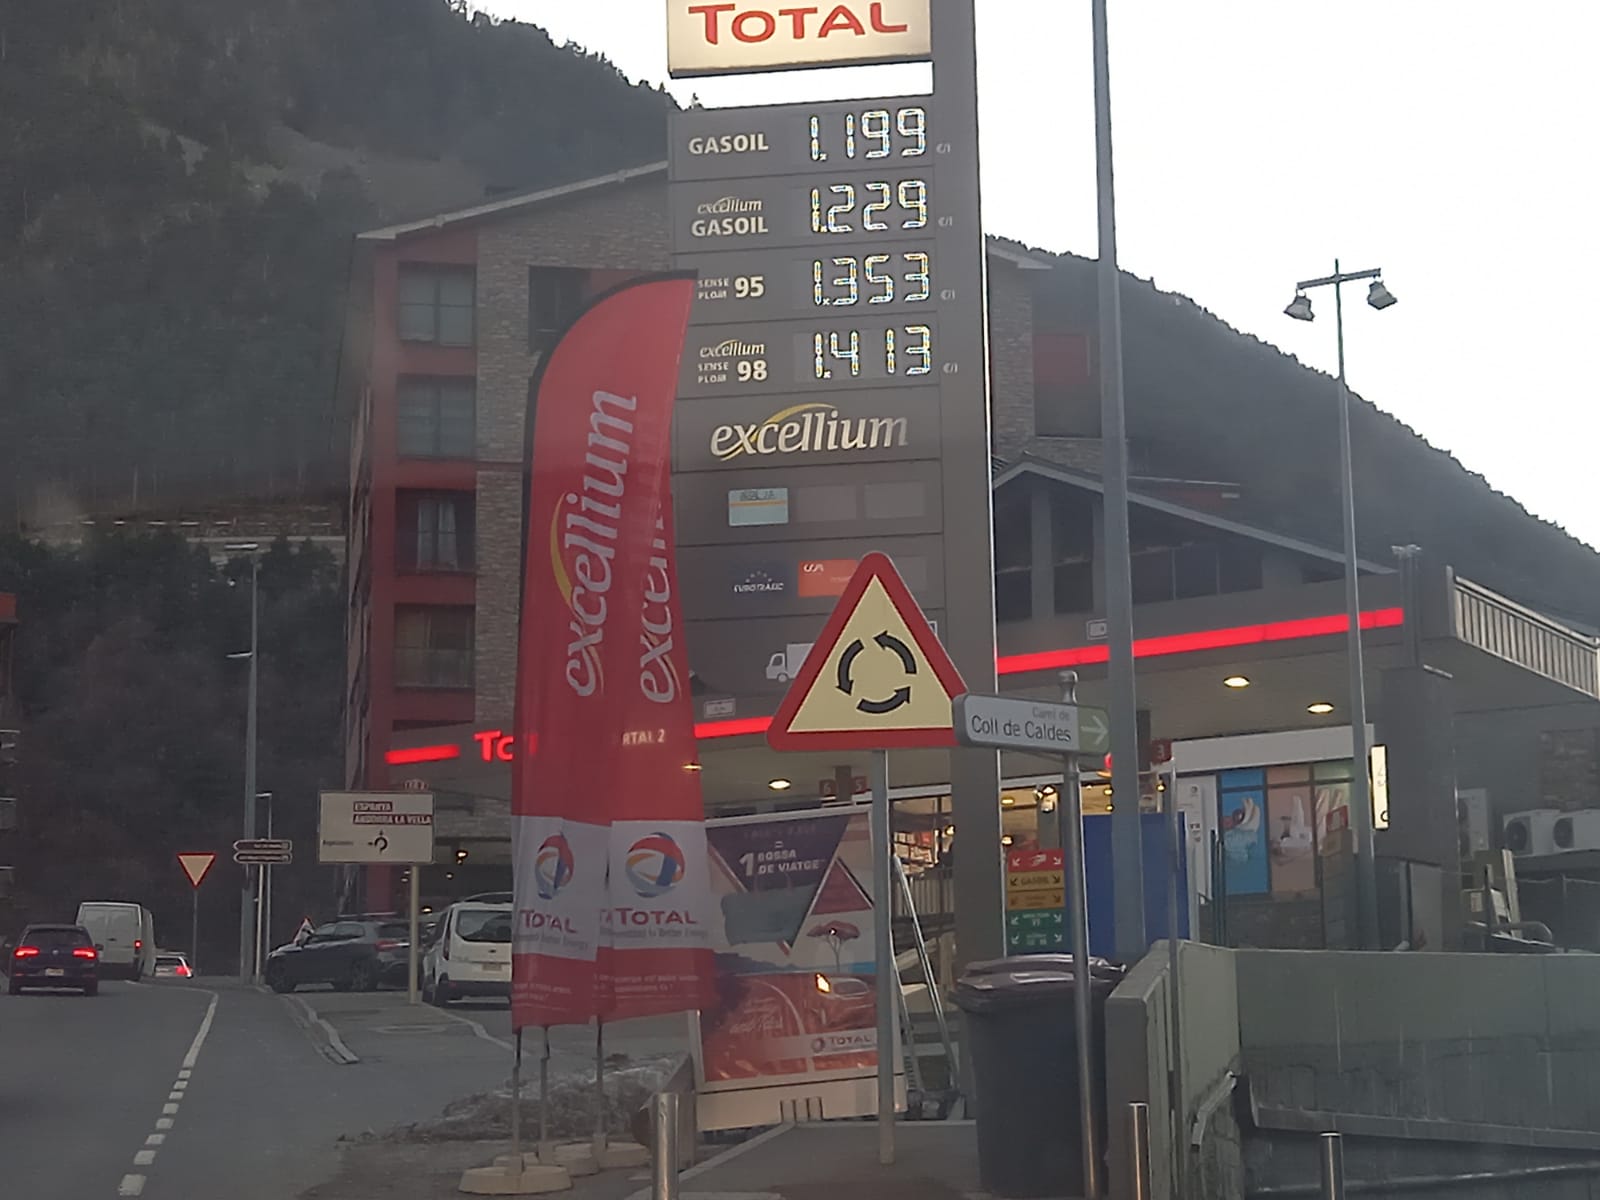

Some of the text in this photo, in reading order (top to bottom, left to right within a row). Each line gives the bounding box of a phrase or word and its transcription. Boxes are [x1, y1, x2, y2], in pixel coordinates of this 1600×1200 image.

[688, 2, 908, 45] TOTAL
[689, 133, 769, 155] GASOIL
[809, 107, 926, 161] 1.199
[697, 196, 762, 214] excellium
[811, 180, 928, 233] 1.229
[692, 216, 769, 236] GASOIL
[734, 276, 765, 298] 95
[812, 252, 930, 305] 1.353
[700, 340, 764, 357] excellium
[814, 325, 931, 378] 1.413
[737, 360, 768, 382] 98
[710, 405, 908, 459] excellium
[563, 390, 637, 697] excellium
[971, 715, 1072, 742] Coll de Caldes
[758, 864, 775, 875] DE
[520, 909, 577, 934] TOTAL
[614, 907, 699, 926] TOTAL
[829, 1034, 872, 1046] TOTAL
